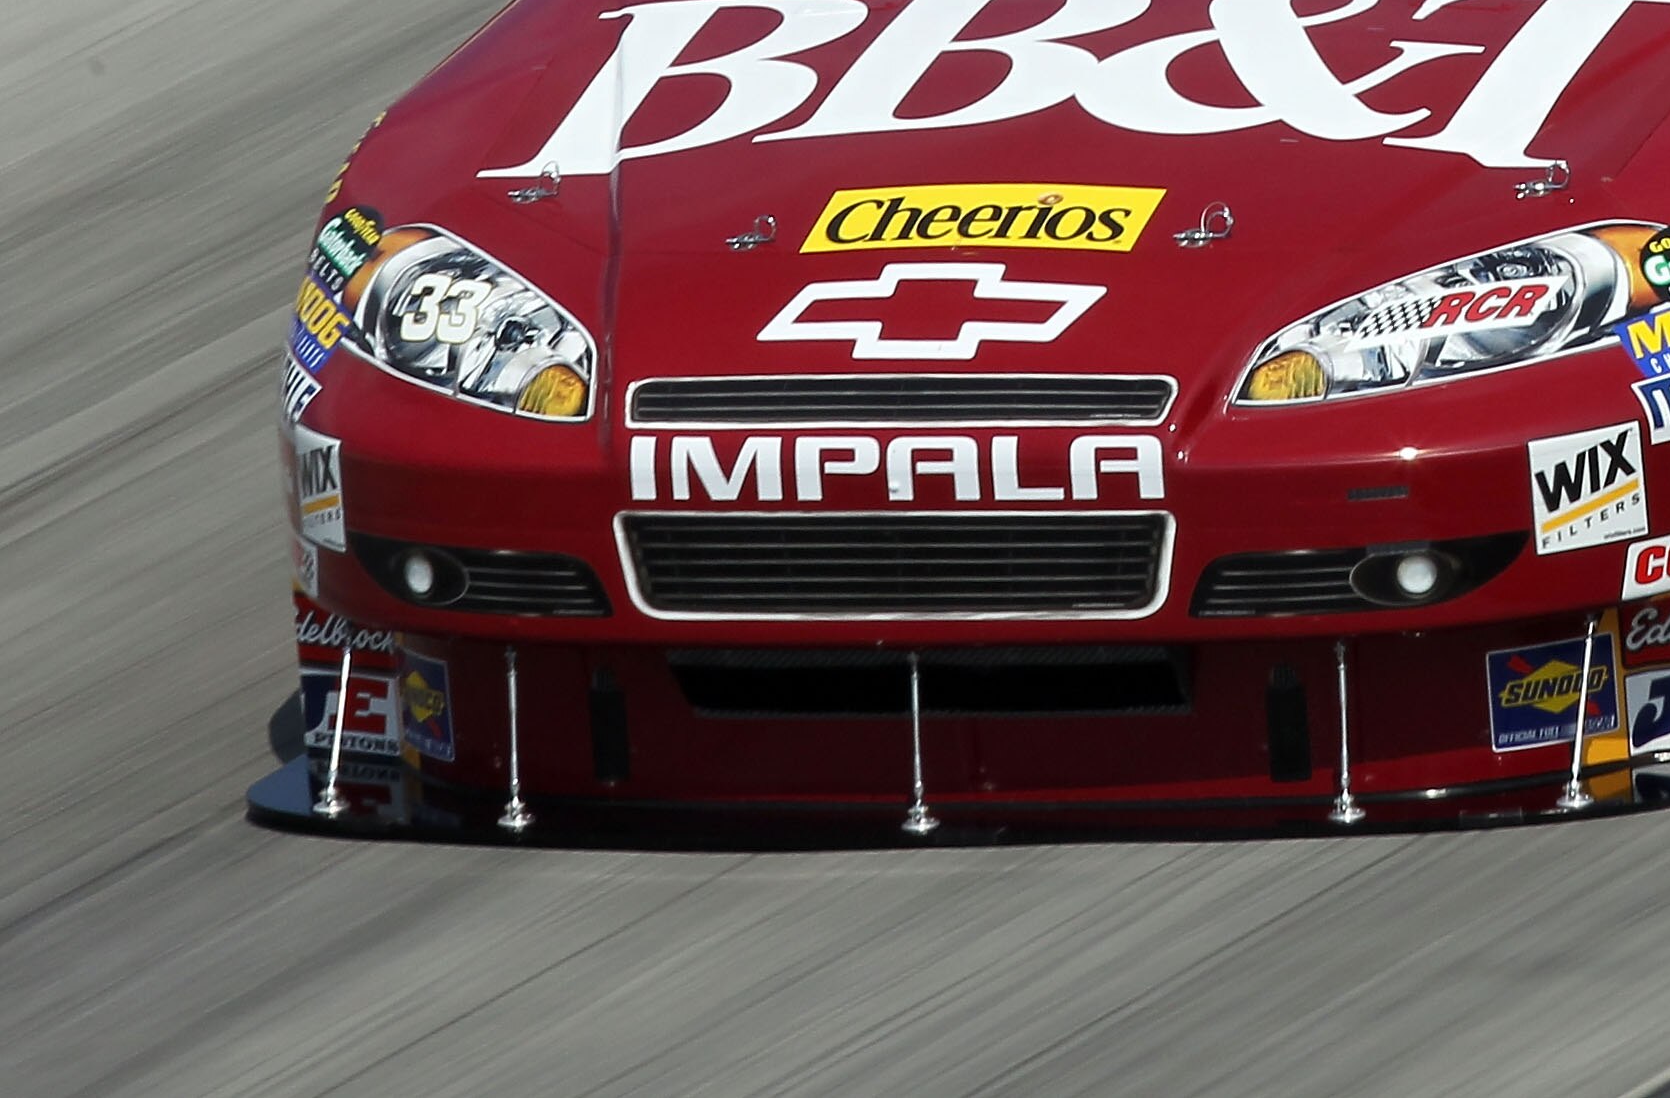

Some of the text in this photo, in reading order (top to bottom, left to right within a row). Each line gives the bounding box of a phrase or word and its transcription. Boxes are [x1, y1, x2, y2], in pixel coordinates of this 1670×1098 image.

[825, 191, 1130, 245] Cheerios
[400, 273, 493, 345] 33
[1422, 284, 1549, 328] RCR
[630, 434, 1166, 501] IMPALA
[1535, 430, 1637, 514] WIX
[1542, 493, 1641, 549] FILTERS
[296, 611, 395, 654] delbock
